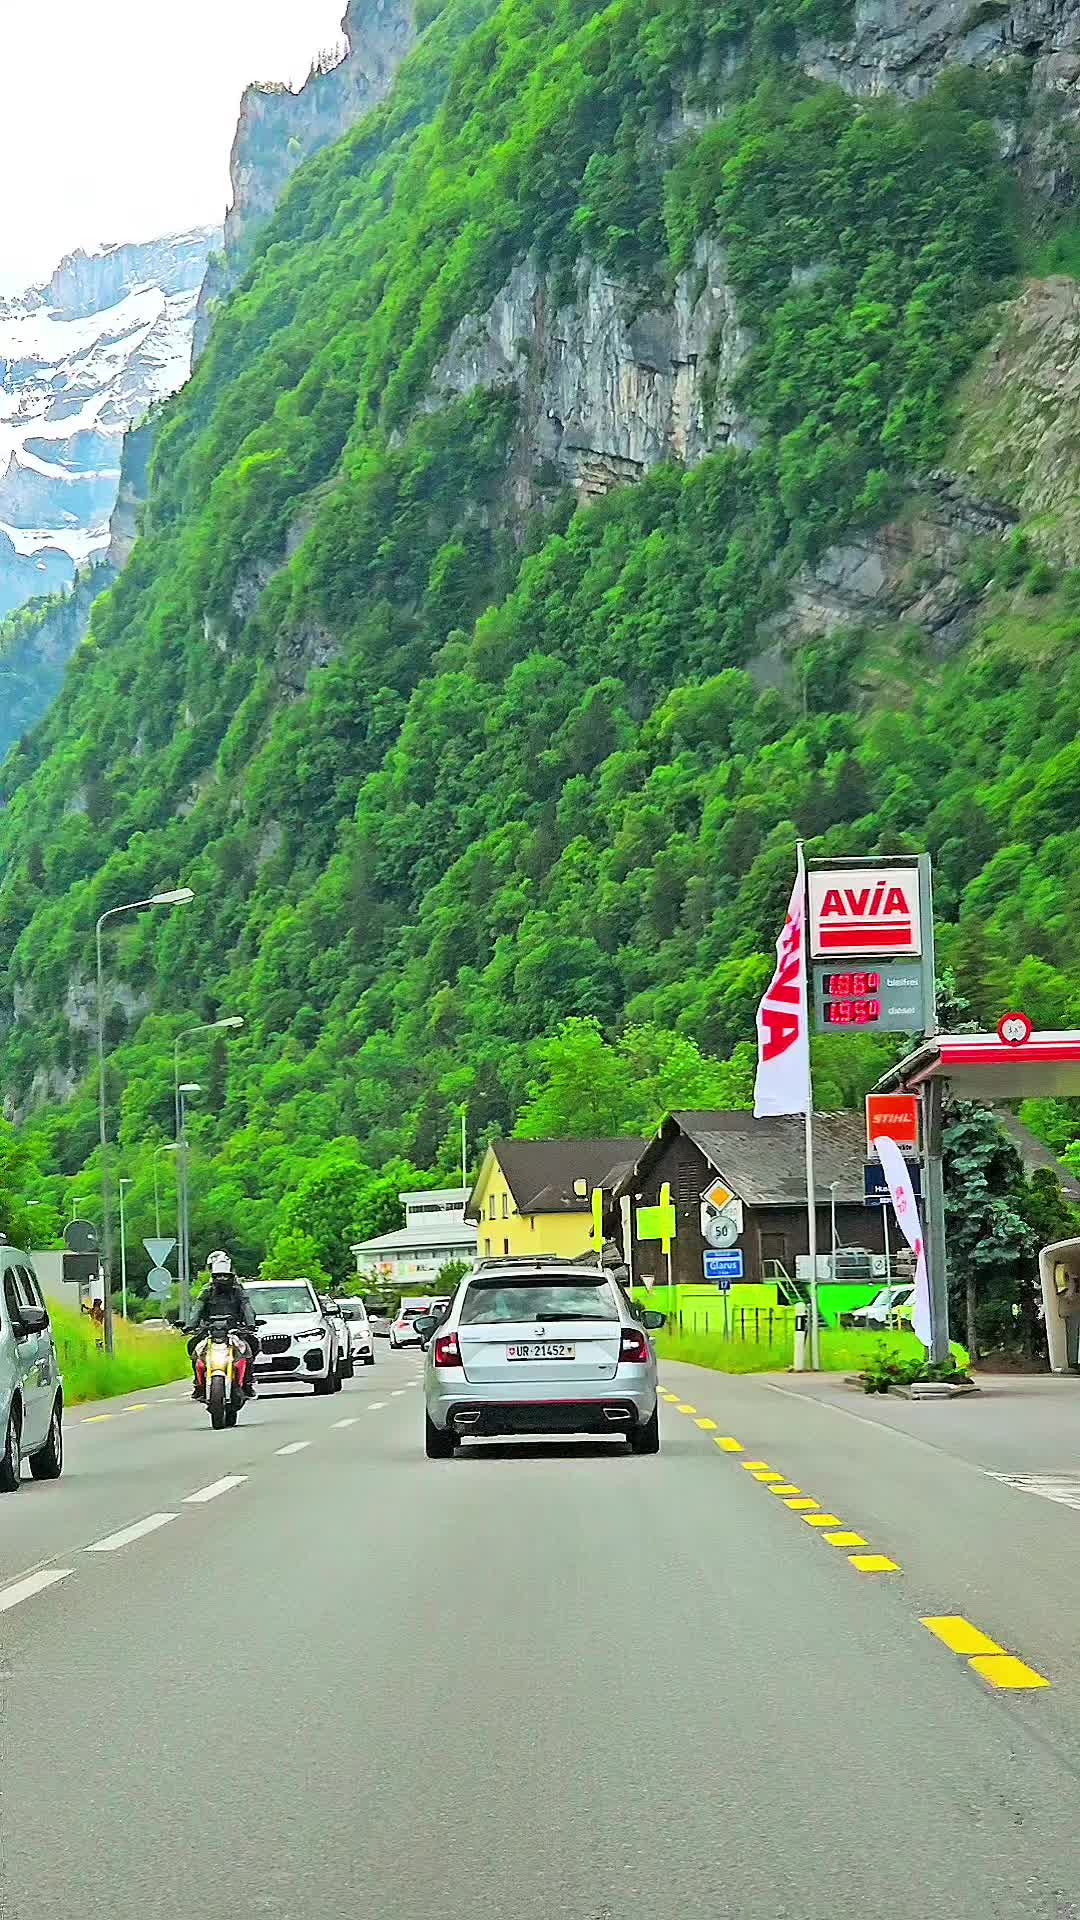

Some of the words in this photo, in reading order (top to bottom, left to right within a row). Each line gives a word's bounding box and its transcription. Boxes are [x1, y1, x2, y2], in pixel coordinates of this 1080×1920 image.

[888, 1006, 916, 1015] diesel
[872, 1113, 912, 1124] STIHL
[715, 1225, 728, 1237] 50
[709, 1261, 737, 1270] Glarus
[720, 1281, 729, 1289] 17
